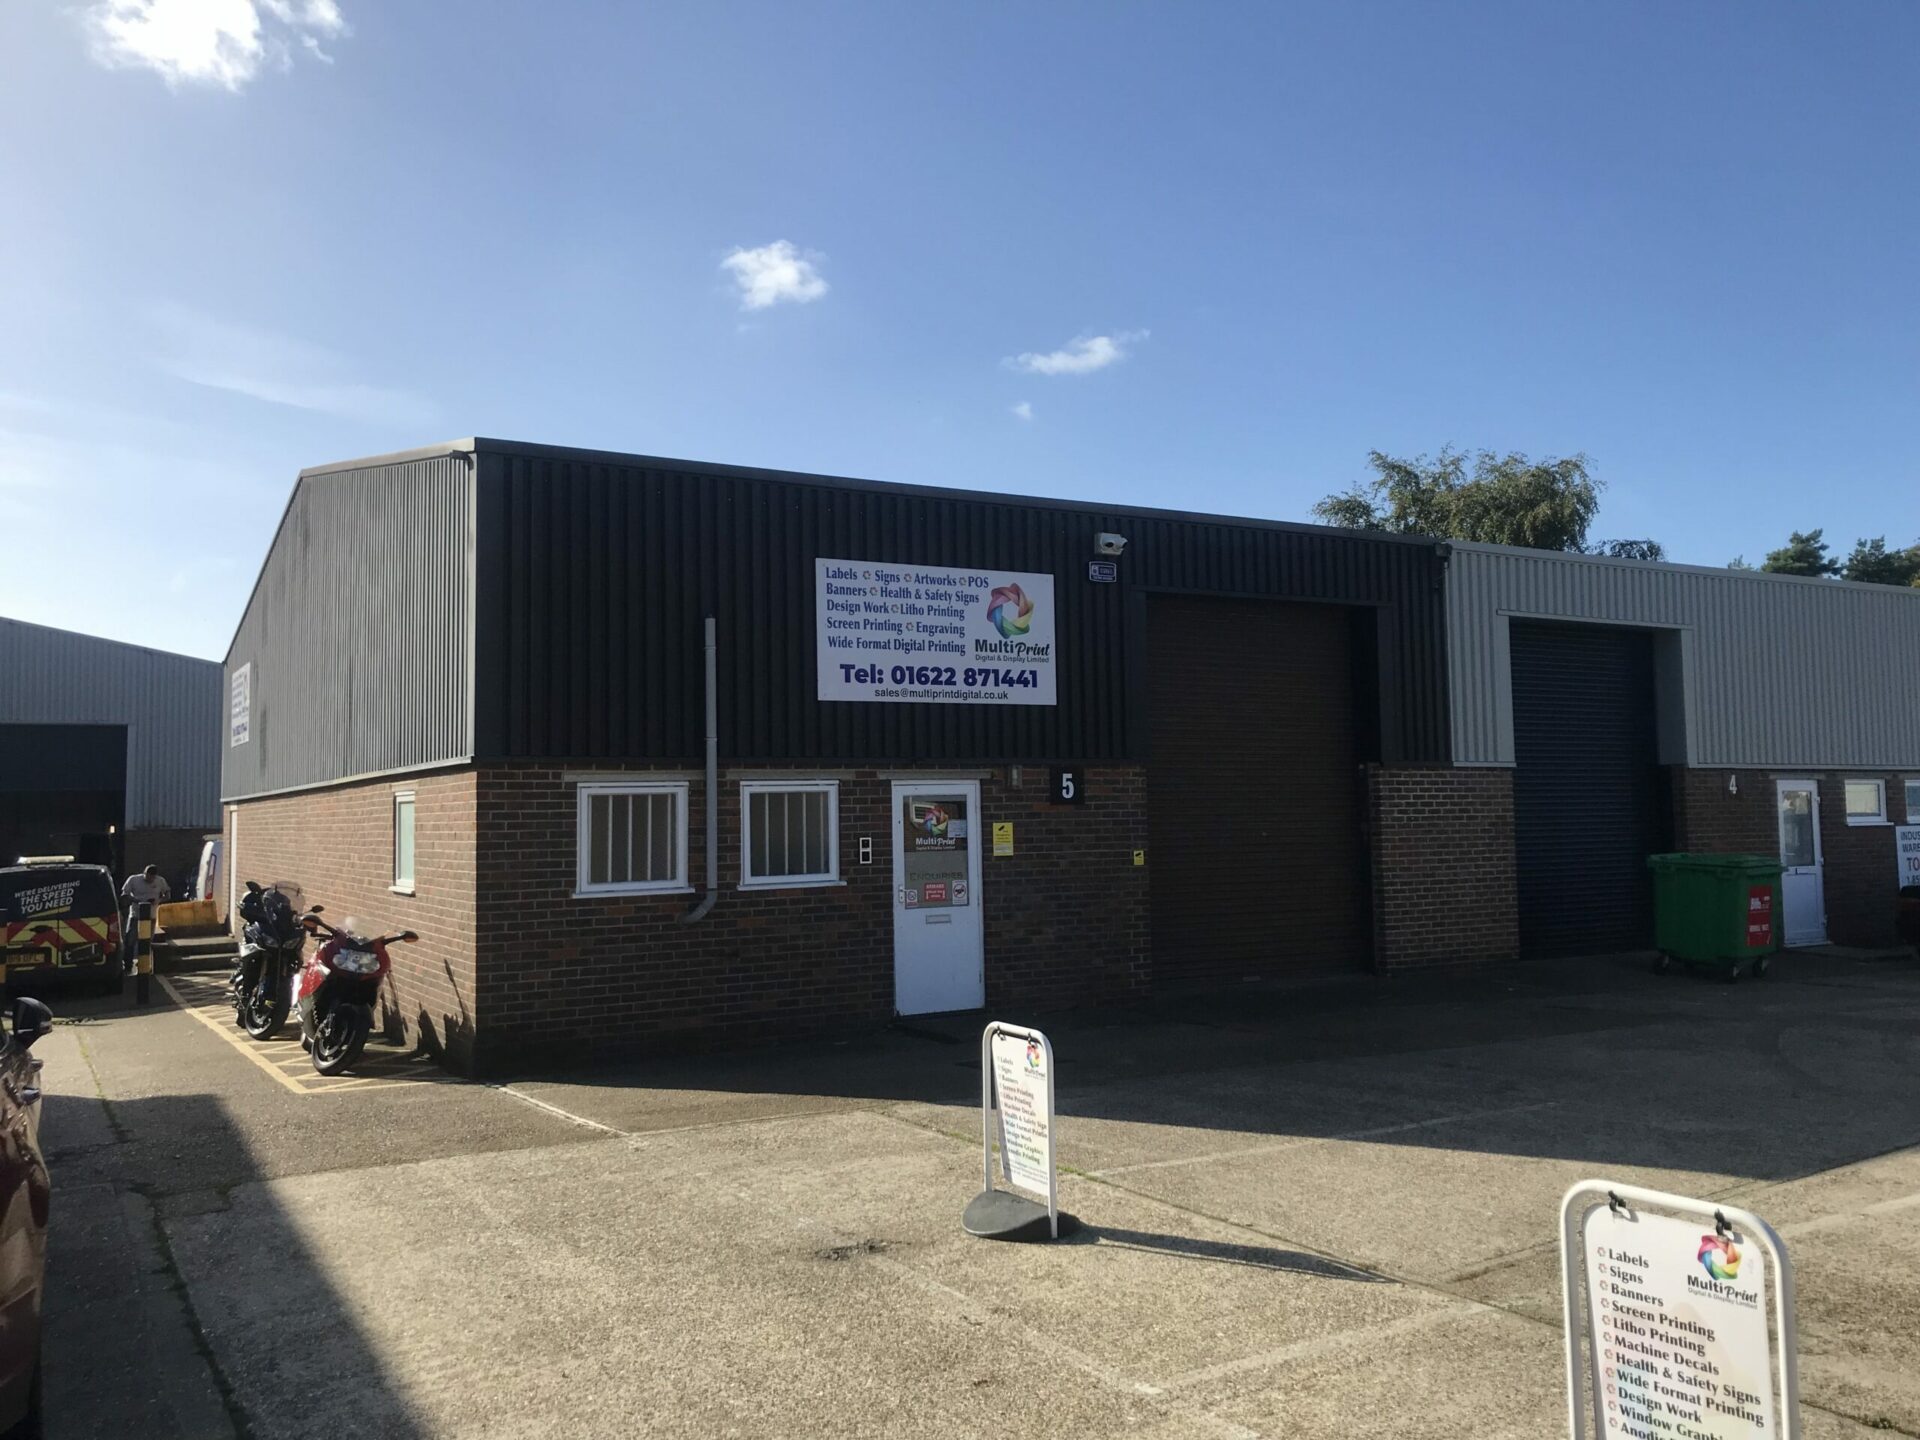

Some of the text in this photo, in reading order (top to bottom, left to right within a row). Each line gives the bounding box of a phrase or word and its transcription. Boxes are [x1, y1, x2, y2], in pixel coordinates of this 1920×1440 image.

[825, 567, 989, 588] Labels Signs Artworks POS
[826, 582, 980, 606] Banners Health & Safety Signs
[826, 599, 965, 621] Design Work Litho Printing
[826, 616, 965, 638] Screen Printing Engraving
[827, 636, 966, 656] Wide Format Digital Printing
[975, 654, 996, 662] Digital
[1003, 655, 1026, 664] Display
[839, 663, 1038, 688] Tel: 01622 871441
[874, 688, 1009, 701] sales@multiprintdigital.co.uk
[1062, 773, 1074, 799] 5
[1729, 774, 1738, 794] 4
[20, 888, 75, 905] THE SPEED
[37, 880, 81, 894] DELIVERING
[20, 896, 74, 914] YOU NEED
[1609, 1248, 1649, 1269] Labels
[1610, 1265, 1644, 1284] Signs
[1611, 1282, 1664, 1307] Banners
[1612, 1300, 1715, 1342] Screen Printing
[1613, 1317, 1706, 1357] Litho Printing
[1614, 1335, 1720, 1376] Machine Decals
[1615, 1352, 1762, 1405] Health & Safety Signs
[1616, 1369, 1765, 1429] Wide Format Printing
[1618, 1386, 1703, 1424] Design Work
[1619, 1403, 1673, 1431] Window
